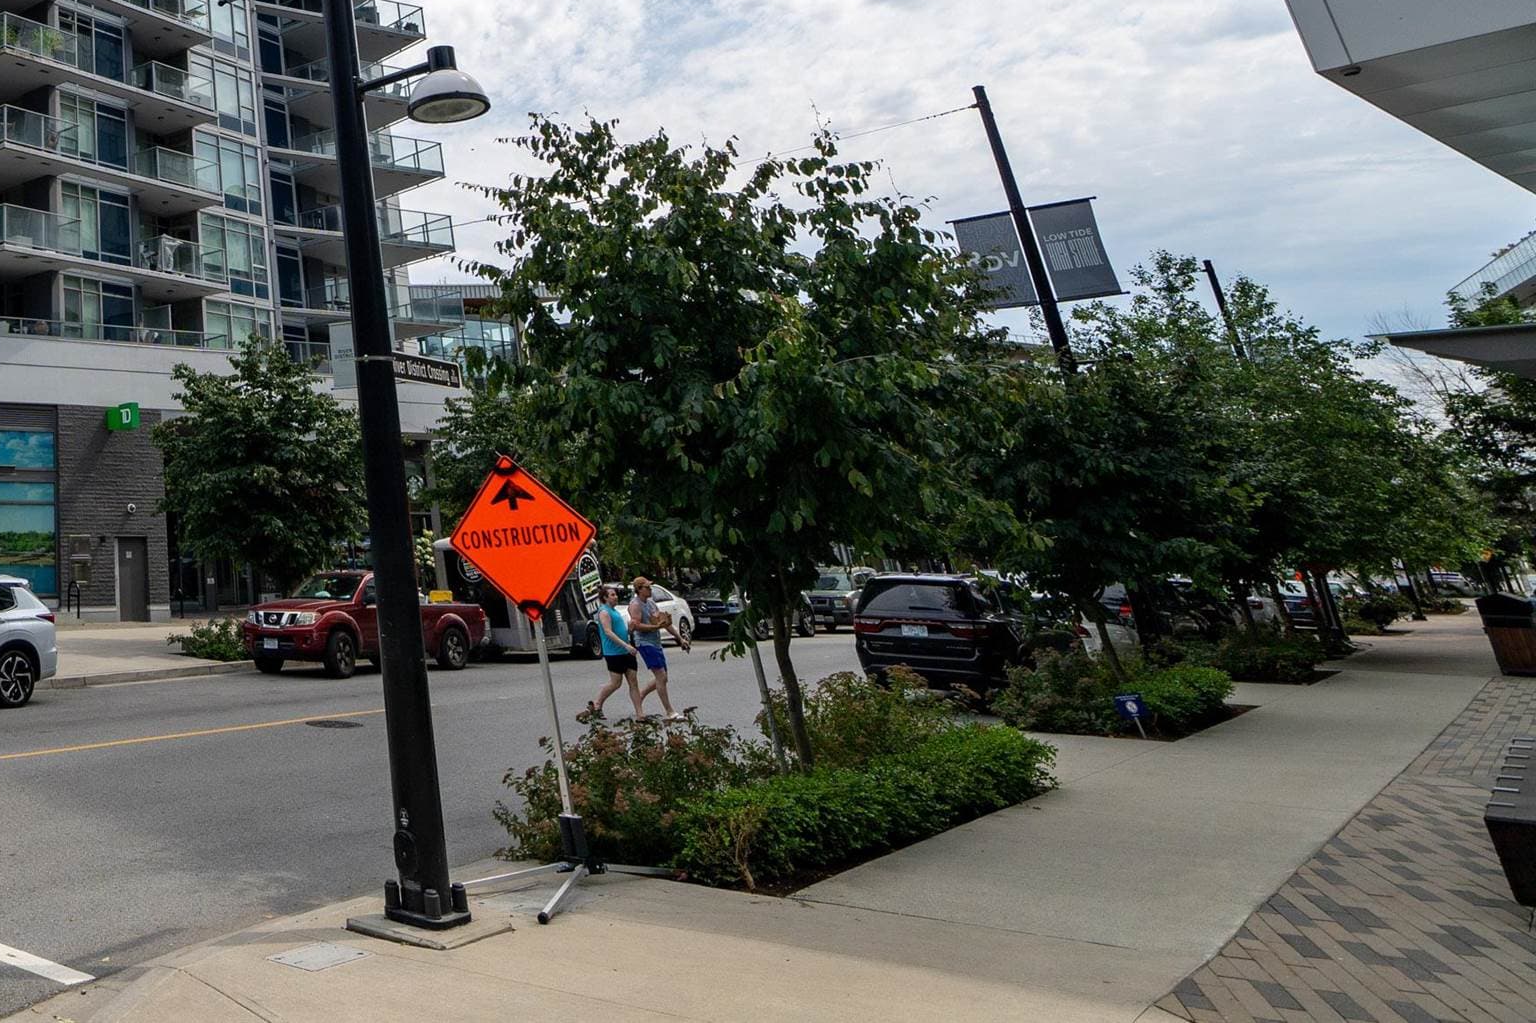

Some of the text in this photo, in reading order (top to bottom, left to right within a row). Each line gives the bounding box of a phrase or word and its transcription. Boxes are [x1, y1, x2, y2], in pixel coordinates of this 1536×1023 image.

[1043, 227, 1094, 242] LOW TIDE
[120, 408, 132, 424] TD
[461, 522, 581, 550] CONSTRUCTION
